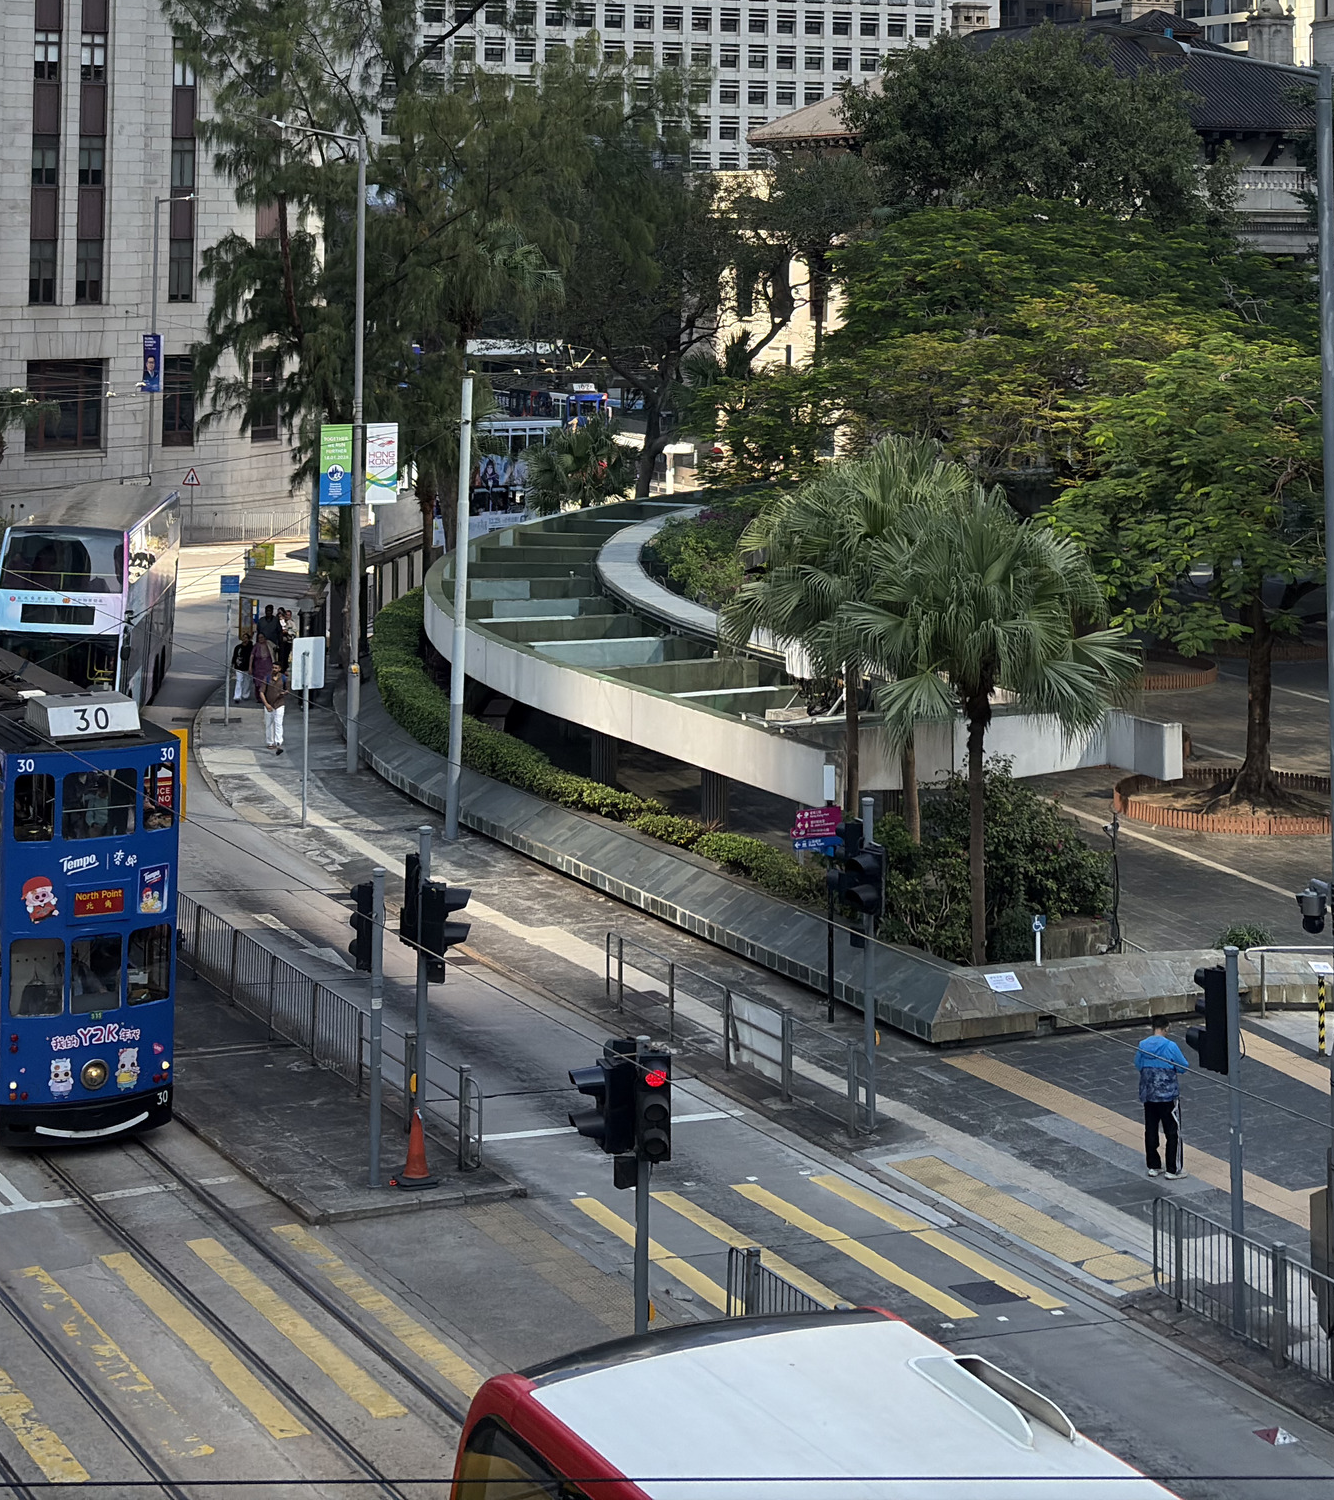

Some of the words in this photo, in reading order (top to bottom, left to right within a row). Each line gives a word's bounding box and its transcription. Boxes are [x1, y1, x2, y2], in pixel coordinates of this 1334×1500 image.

[73, 707, 110, 731] 30
[160, 747, 175, 761] 30
[17, 759, 35, 772] 30
[59, 854, 99, 874] Tempo
[75, 891, 99, 901] North
[101, 889, 123, 899] Point
[85, 900, 112, 911] 北角
[157, 1090, 169, 1106] 30
